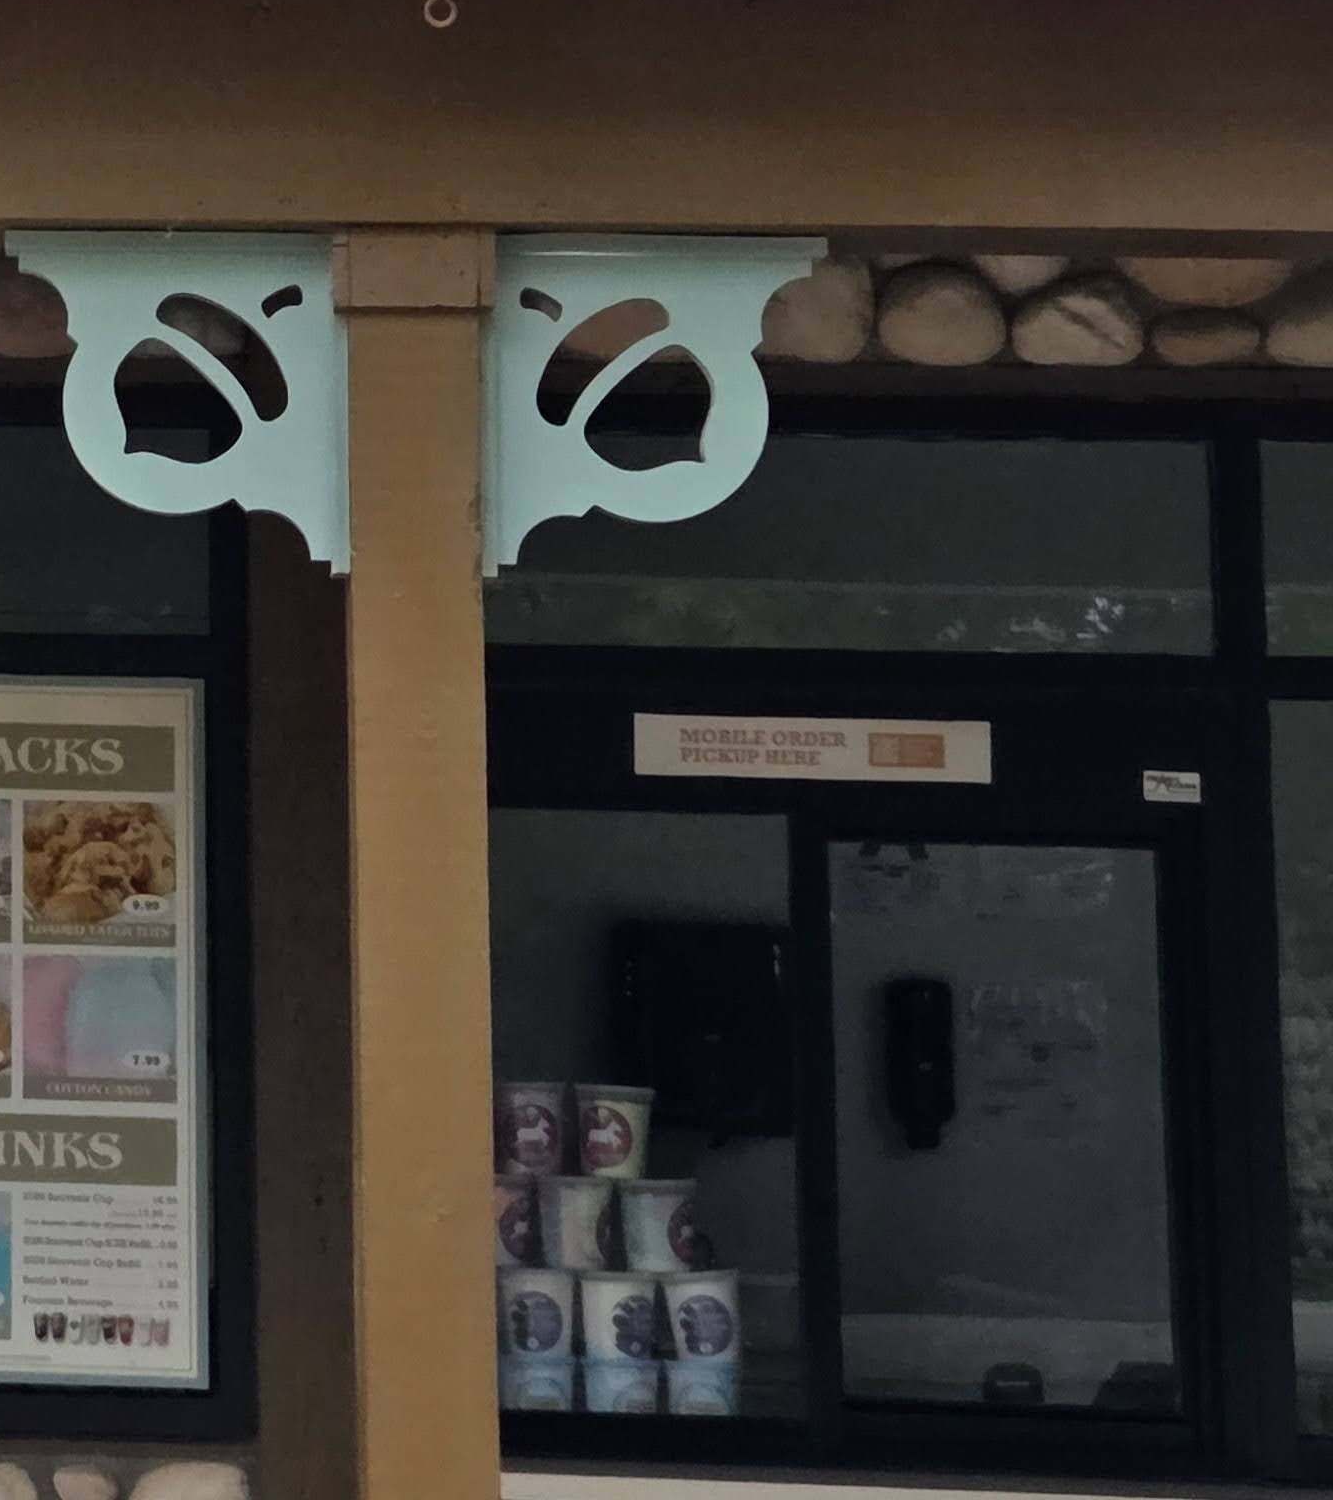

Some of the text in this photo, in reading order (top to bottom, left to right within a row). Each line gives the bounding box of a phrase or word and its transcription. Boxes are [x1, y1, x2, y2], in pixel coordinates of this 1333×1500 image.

[678, 728, 847, 748] MOBILE ORDER
[679, 747, 822, 767] PICKUP HERE
